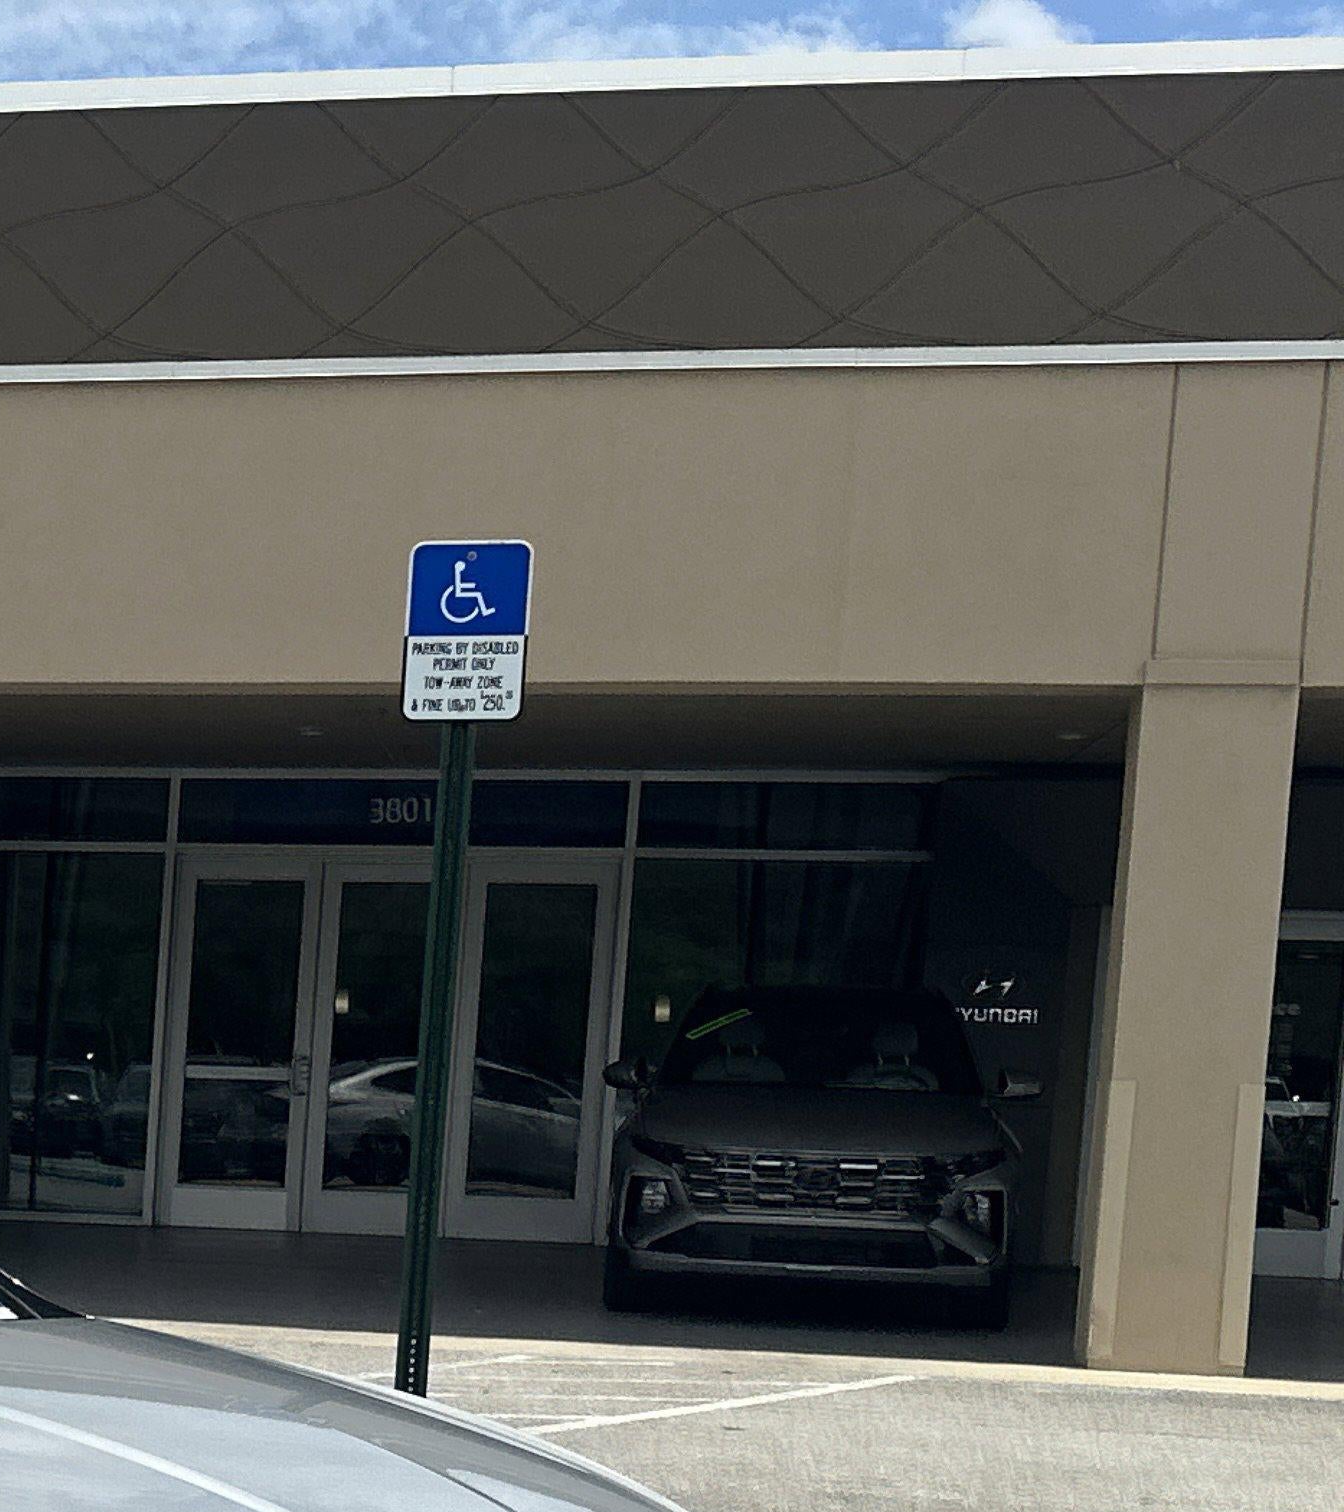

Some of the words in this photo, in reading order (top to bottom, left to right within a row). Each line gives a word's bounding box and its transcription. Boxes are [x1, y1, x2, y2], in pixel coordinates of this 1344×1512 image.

[411, 641, 452, 655] PARKING
[456, 642, 469, 655] BY
[472, 640, 519, 655] DISABLED
[433, 657, 468, 671] PERMIT
[472, 657, 495, 671] ONLY
[477, 675, 503, 689] ZONE
[368, 796, 433, 824] 3801
